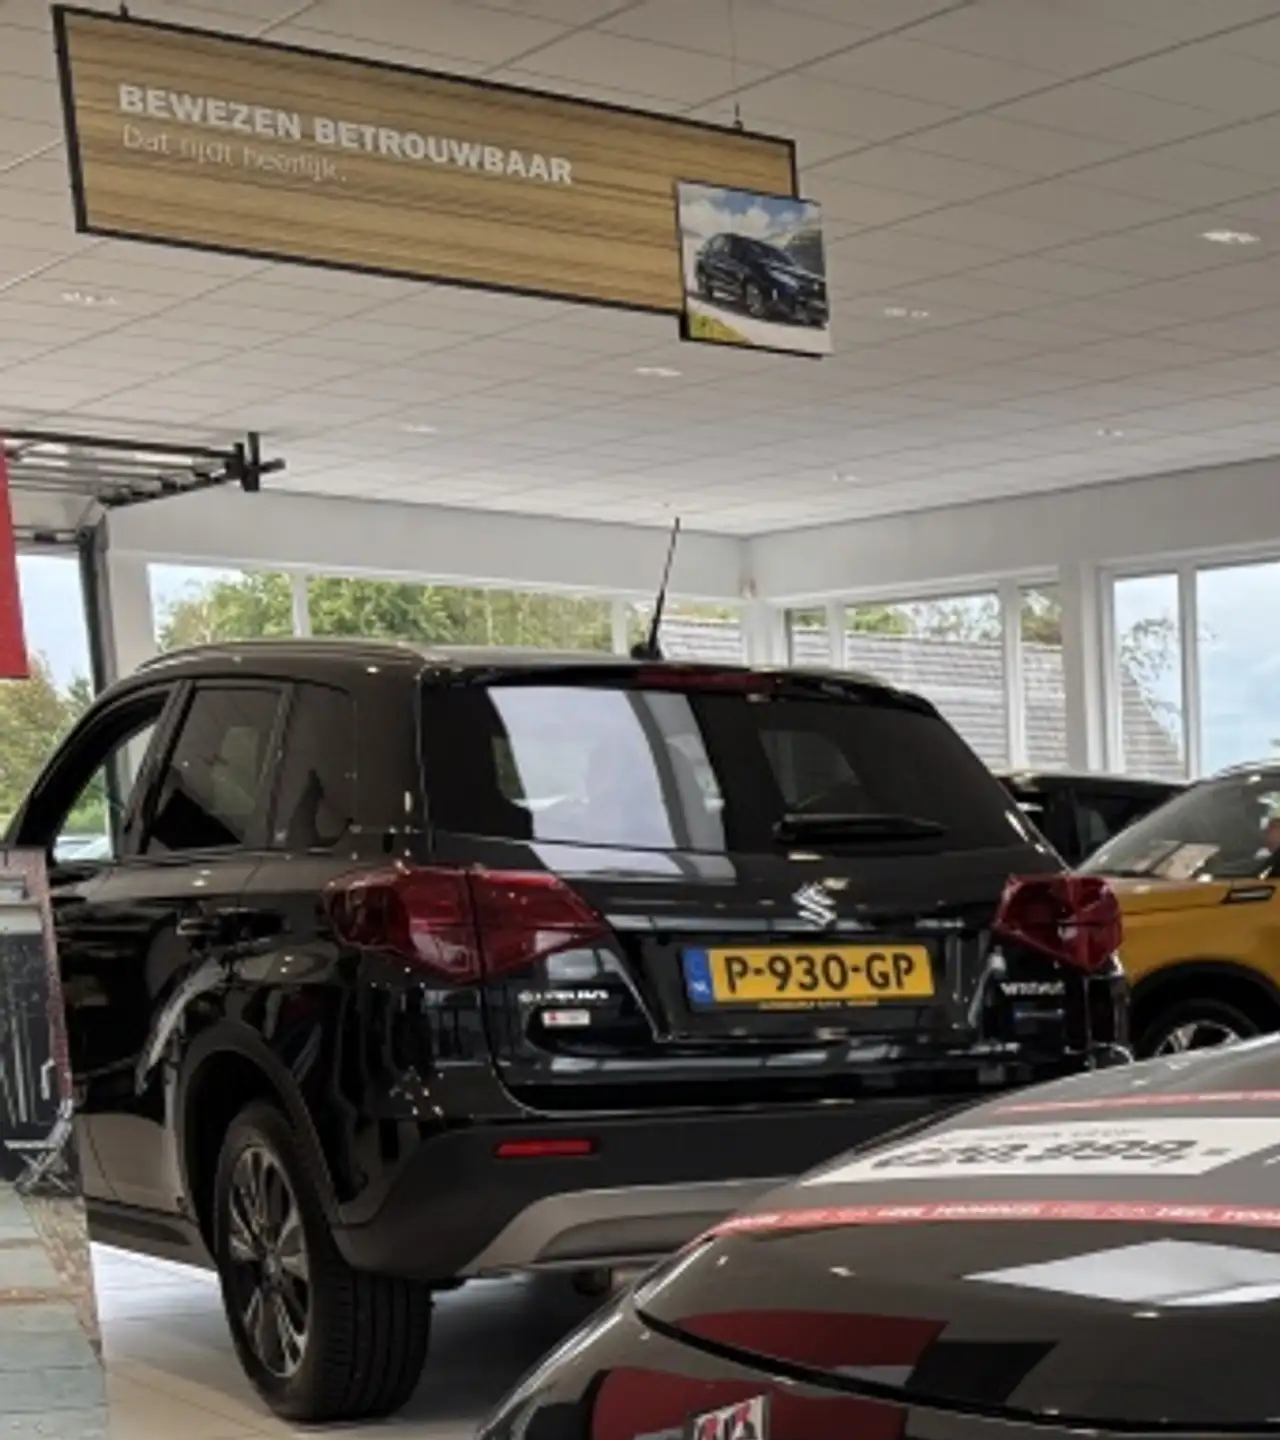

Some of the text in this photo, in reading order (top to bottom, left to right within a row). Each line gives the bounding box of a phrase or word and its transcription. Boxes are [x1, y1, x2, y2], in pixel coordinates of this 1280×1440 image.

[119, 83, 574, 185] BEWEZEN BETROUWBAAR
[123, 123, 172, 156] Dat
[724, 952, 917, 994] P-930-GP
